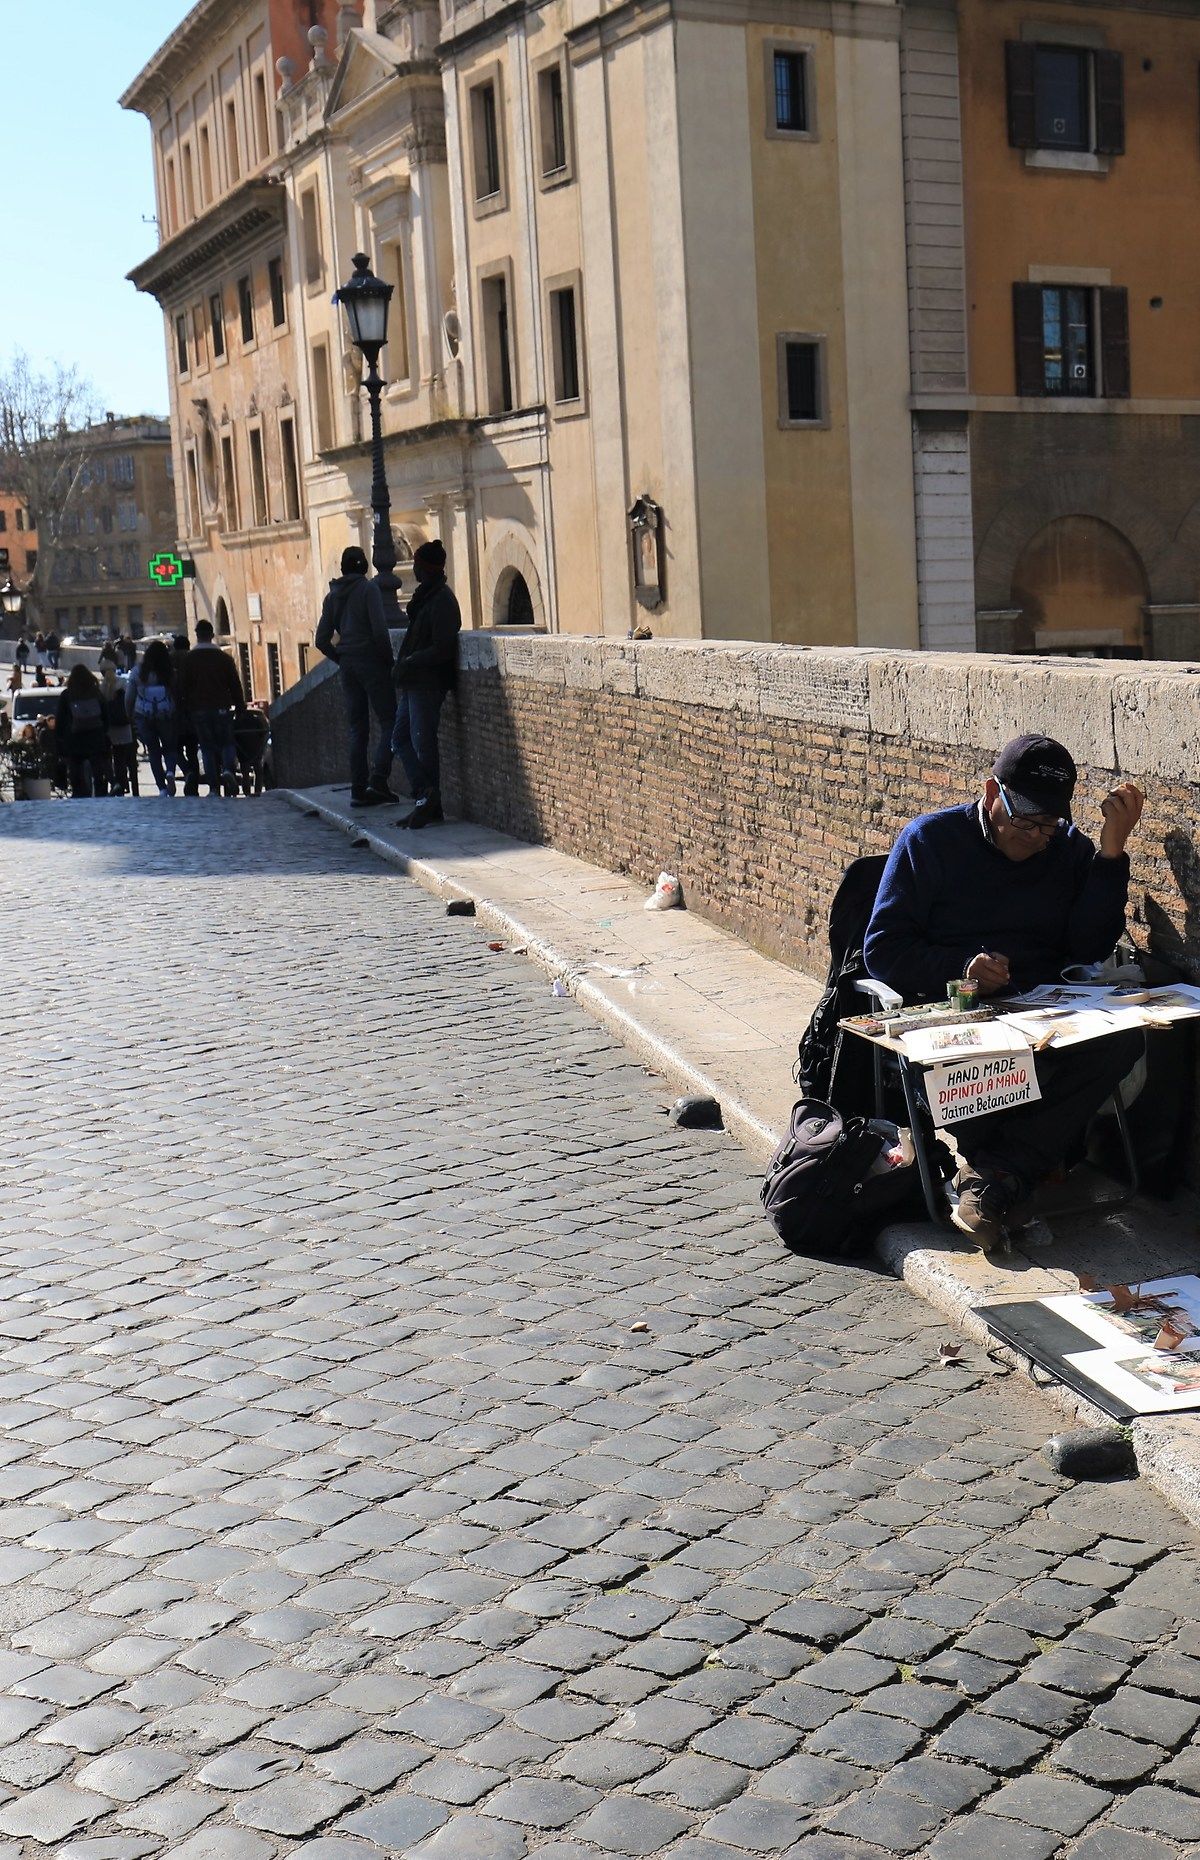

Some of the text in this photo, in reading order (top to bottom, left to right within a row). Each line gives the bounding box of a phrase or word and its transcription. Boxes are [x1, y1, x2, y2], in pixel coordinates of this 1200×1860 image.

[938, 1069, 1026, 1104] DIPINTO A MANO
[947, 1057, 1016, 1086] HAND MADE
[941, 1081, 1031, 1120] Jaime Betancourt
